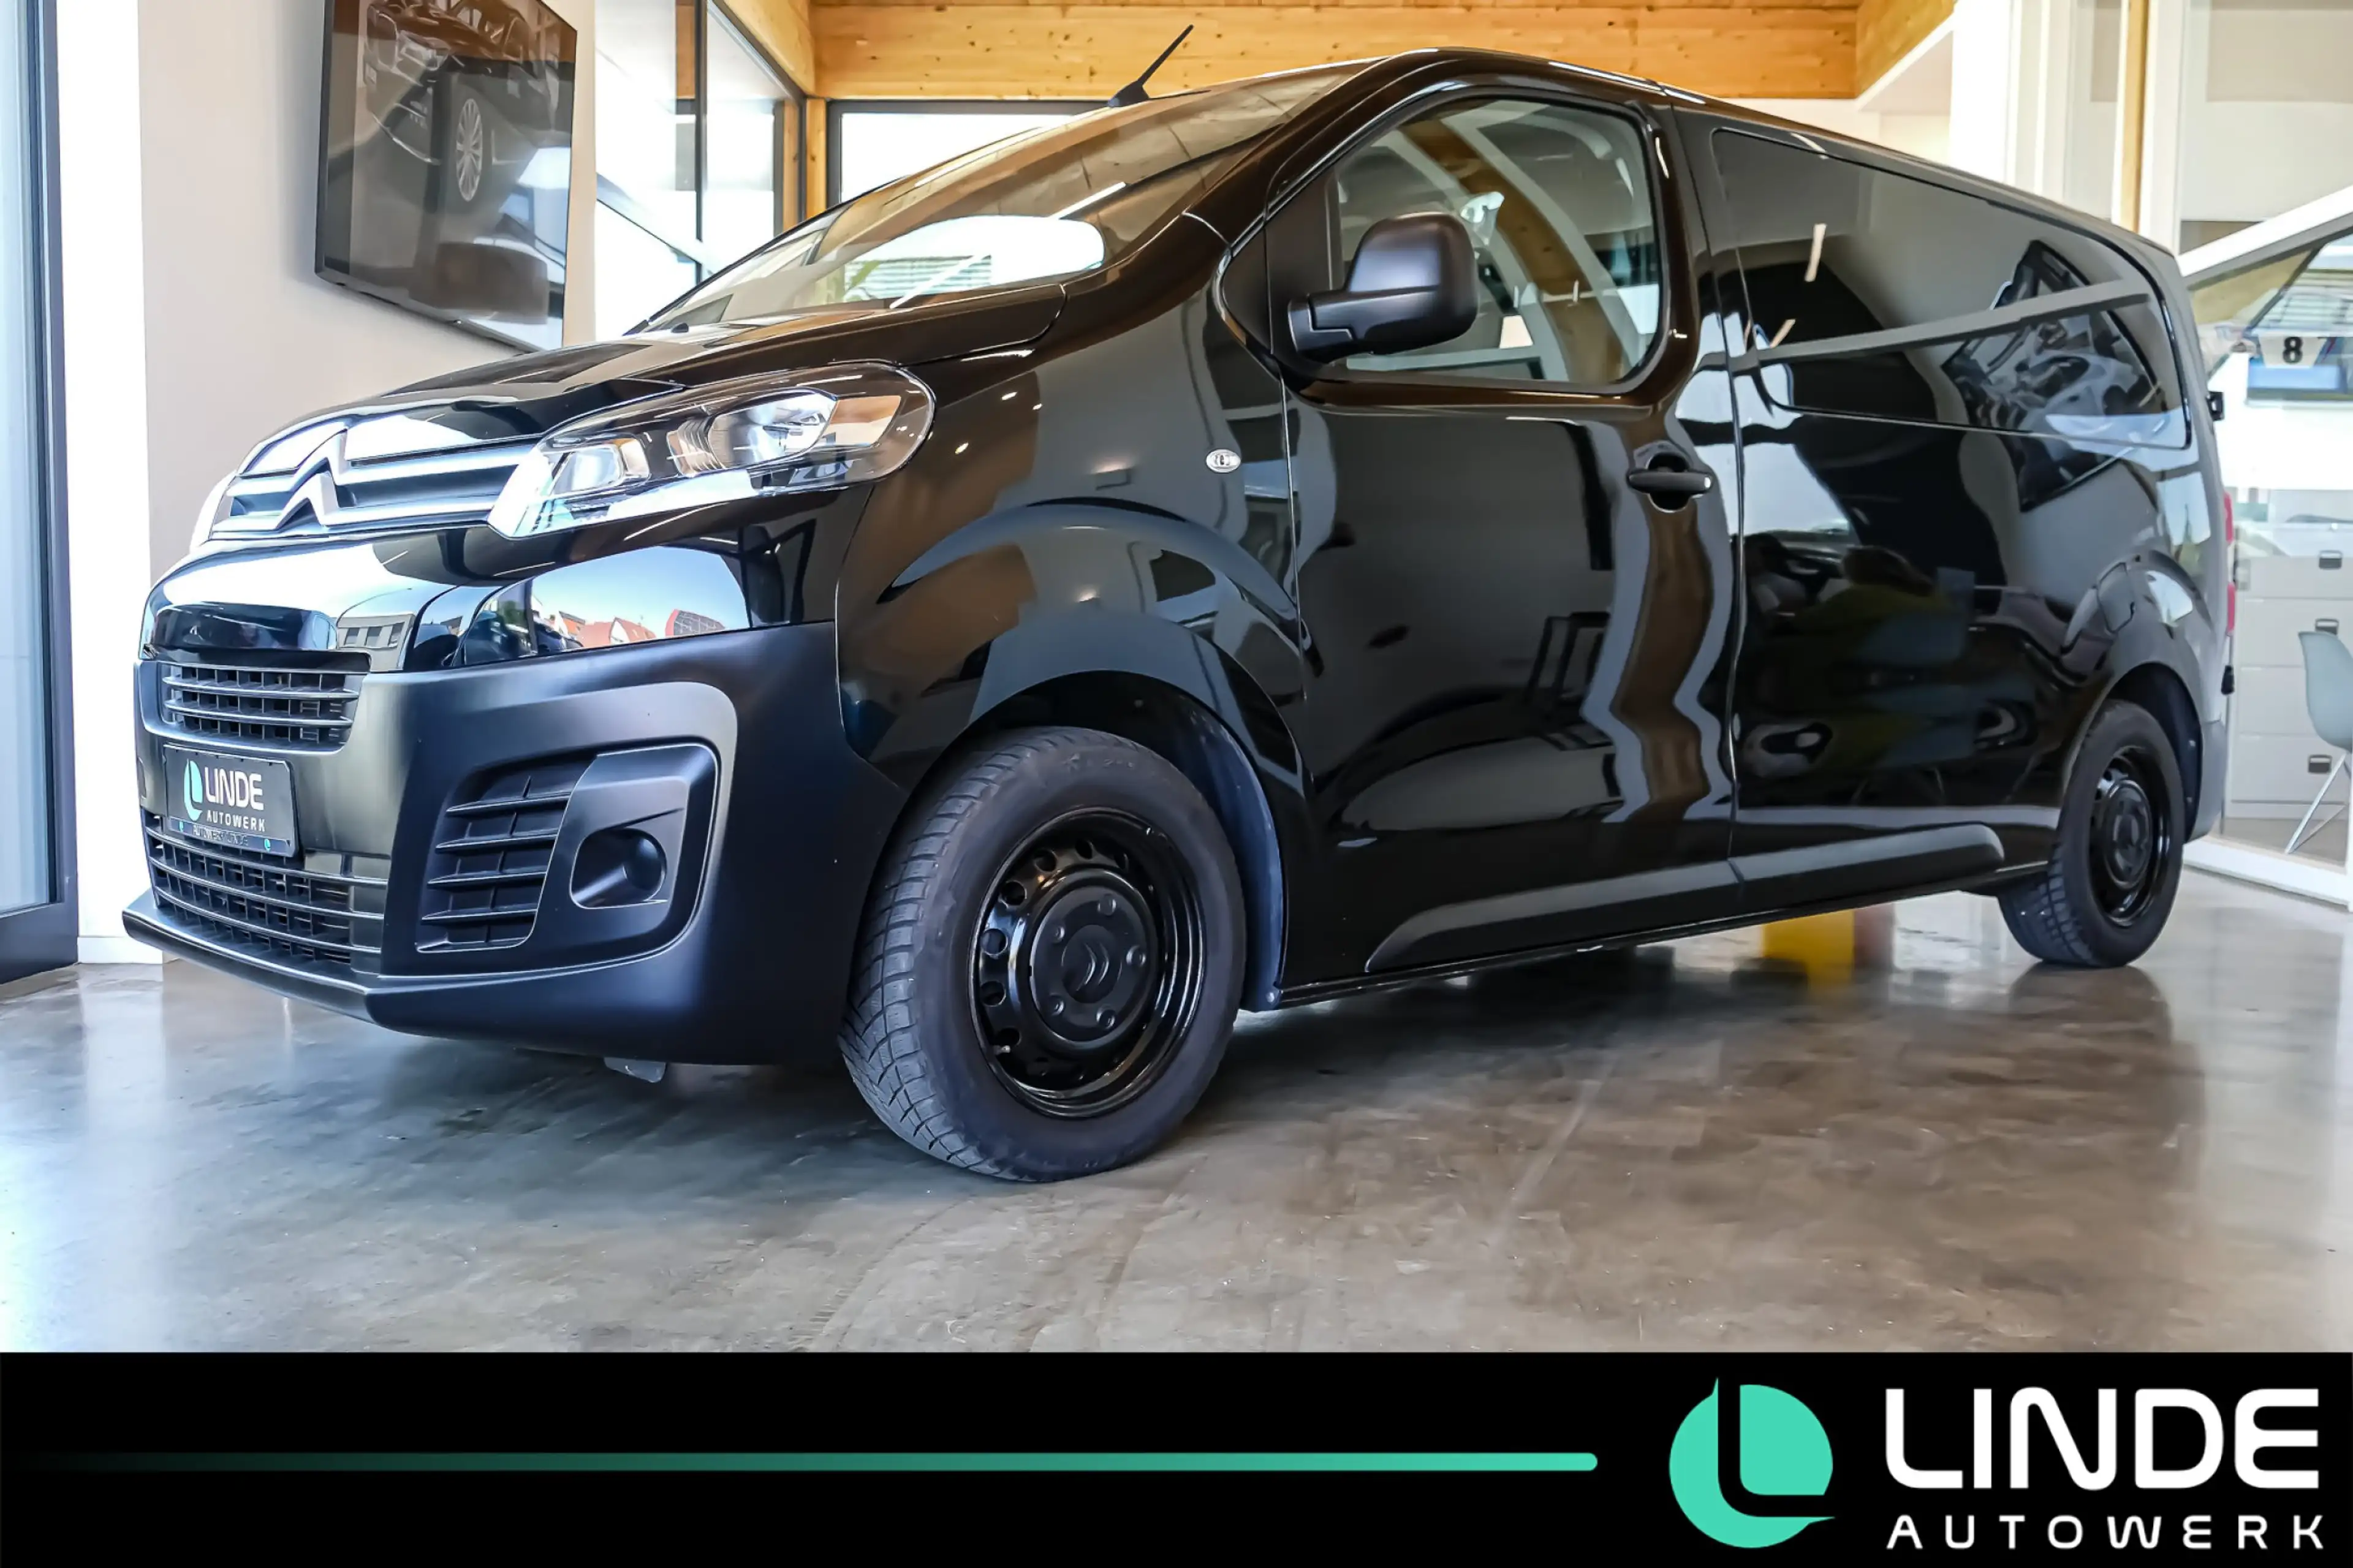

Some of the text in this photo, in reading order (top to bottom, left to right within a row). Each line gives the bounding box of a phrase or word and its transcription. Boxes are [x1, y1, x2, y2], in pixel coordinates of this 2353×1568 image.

[2283, 336, 2303, 364] 8
[204, 767, 265, 811] LINDE
[206, 809, 266, 832] AUTOWERK
